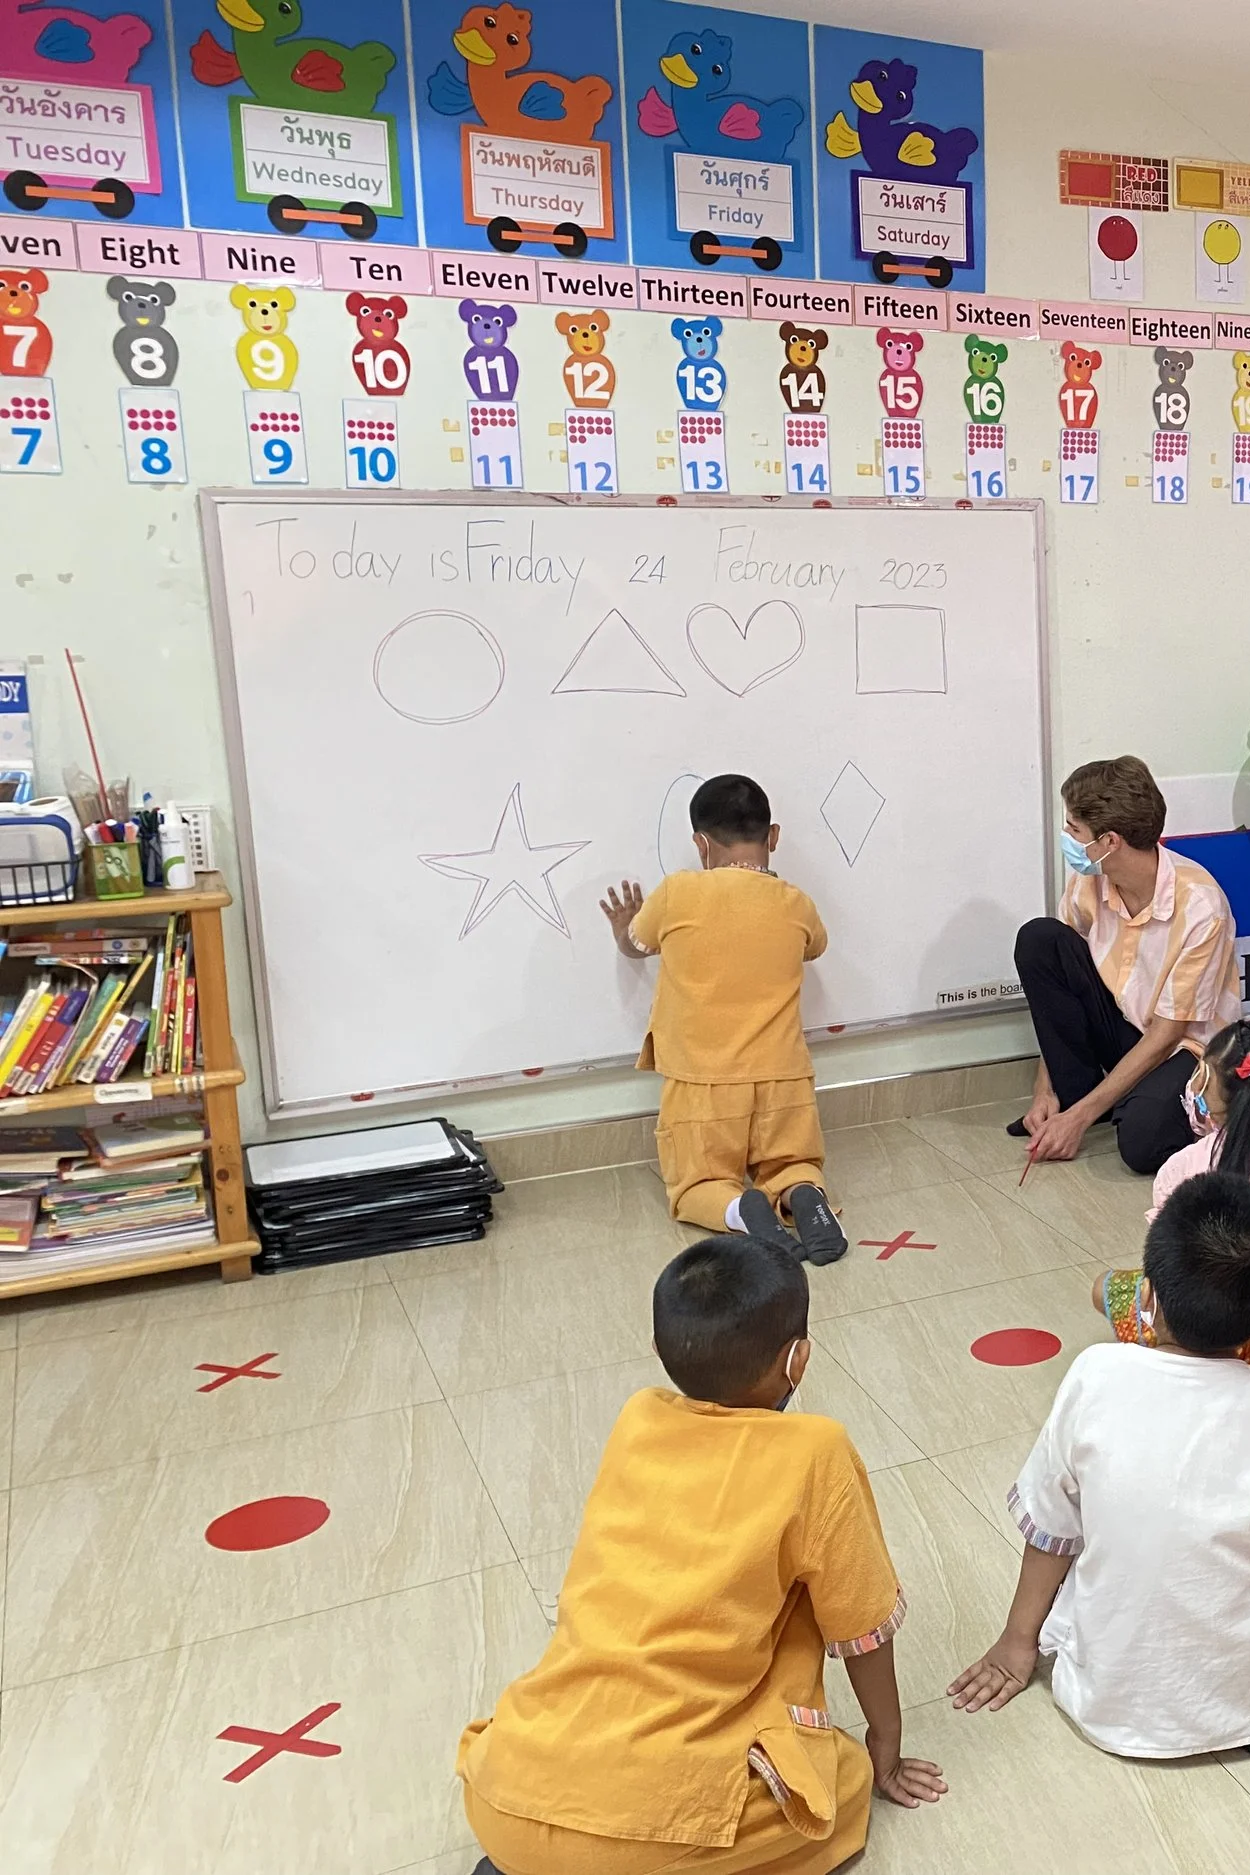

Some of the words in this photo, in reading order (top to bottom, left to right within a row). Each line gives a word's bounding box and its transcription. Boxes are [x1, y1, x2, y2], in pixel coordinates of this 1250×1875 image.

[1, 86, 127, 126] วันอังคาร
[7, 136, 127, 173] Tuesday
[280, 116, 352, 160] วันพุธ
[476, 139, 597, 179] วันพฤหัสบดี
[1126, 166, 1158, 184] RED
[252, 161, 384, 196] Wednesday
[700, 160, 770, 199] วันศุกร์
[491, 187, 584, 218] Thursday
[880, 183, 947, 216] วันเสาร์
[708, 204, 764, 229] Friday
[101, 237, 180, 272] Eight
[877, 225, 951, 251] Saturday
[227, 247, 296, 275] Nine
[350, 256, 402, 282] Ten
[442, 264, 529, 293] Eleven
[542, 271, 634, 299] Twelve
[642, 279, 744, 308] Thirteen
[753, 287, 850, 315] Fourteen
[864, 295, 938, 323] Fifteen
[956, 303, 1031, 329] Sixteen
[1041, 309, 1126, 332] Seventeen
[1132, 317, 1211, 345] Eighteen
[4, 325, 38, 368] 7
[130, 337, 167, 380] 8
[249, 339, 285, 382] 9
[354, 350, 408, 390] 10
[468, 355, 509, 395] 11
[565, 361, 611, 400] 12
[678, 365, 723, 403] 13
[781, 372, 824, 408] 14
[880, 376, 919, 411] 15
[966, 383, 1002, 418] 16
[1061, 389, 1096, 423] 17
[1155, 392, 1187, 426] 18
[11, 427, 42, 466] 7
[141, 437, 172, 475] 8
[263, 438, 293, 475] 9
[349, 446, 397, 483] 10
[477, 454, 513, 486] 11
[574, 461, 614, 493] 12
[687, 461, 723, 491] 13
[791, 463, 827, 492] 14
[887, 465, 921, 494] 15
[971, 469, 1004, 498] 16
[1065, 474, 1095, 502] 17
[1156, 475, 1185, 502] 18
[431, 546, 459, 582] is
[467, 519, 585, 617] Friday
[628, 553, 667, 585] 24
[714, 524, 849, 602] February
[878, 557, 949, 590] 2023
[940, 991, 965, 1004] This
[967, 989, 978, 999] is
[980, 987, 997, 998] the
